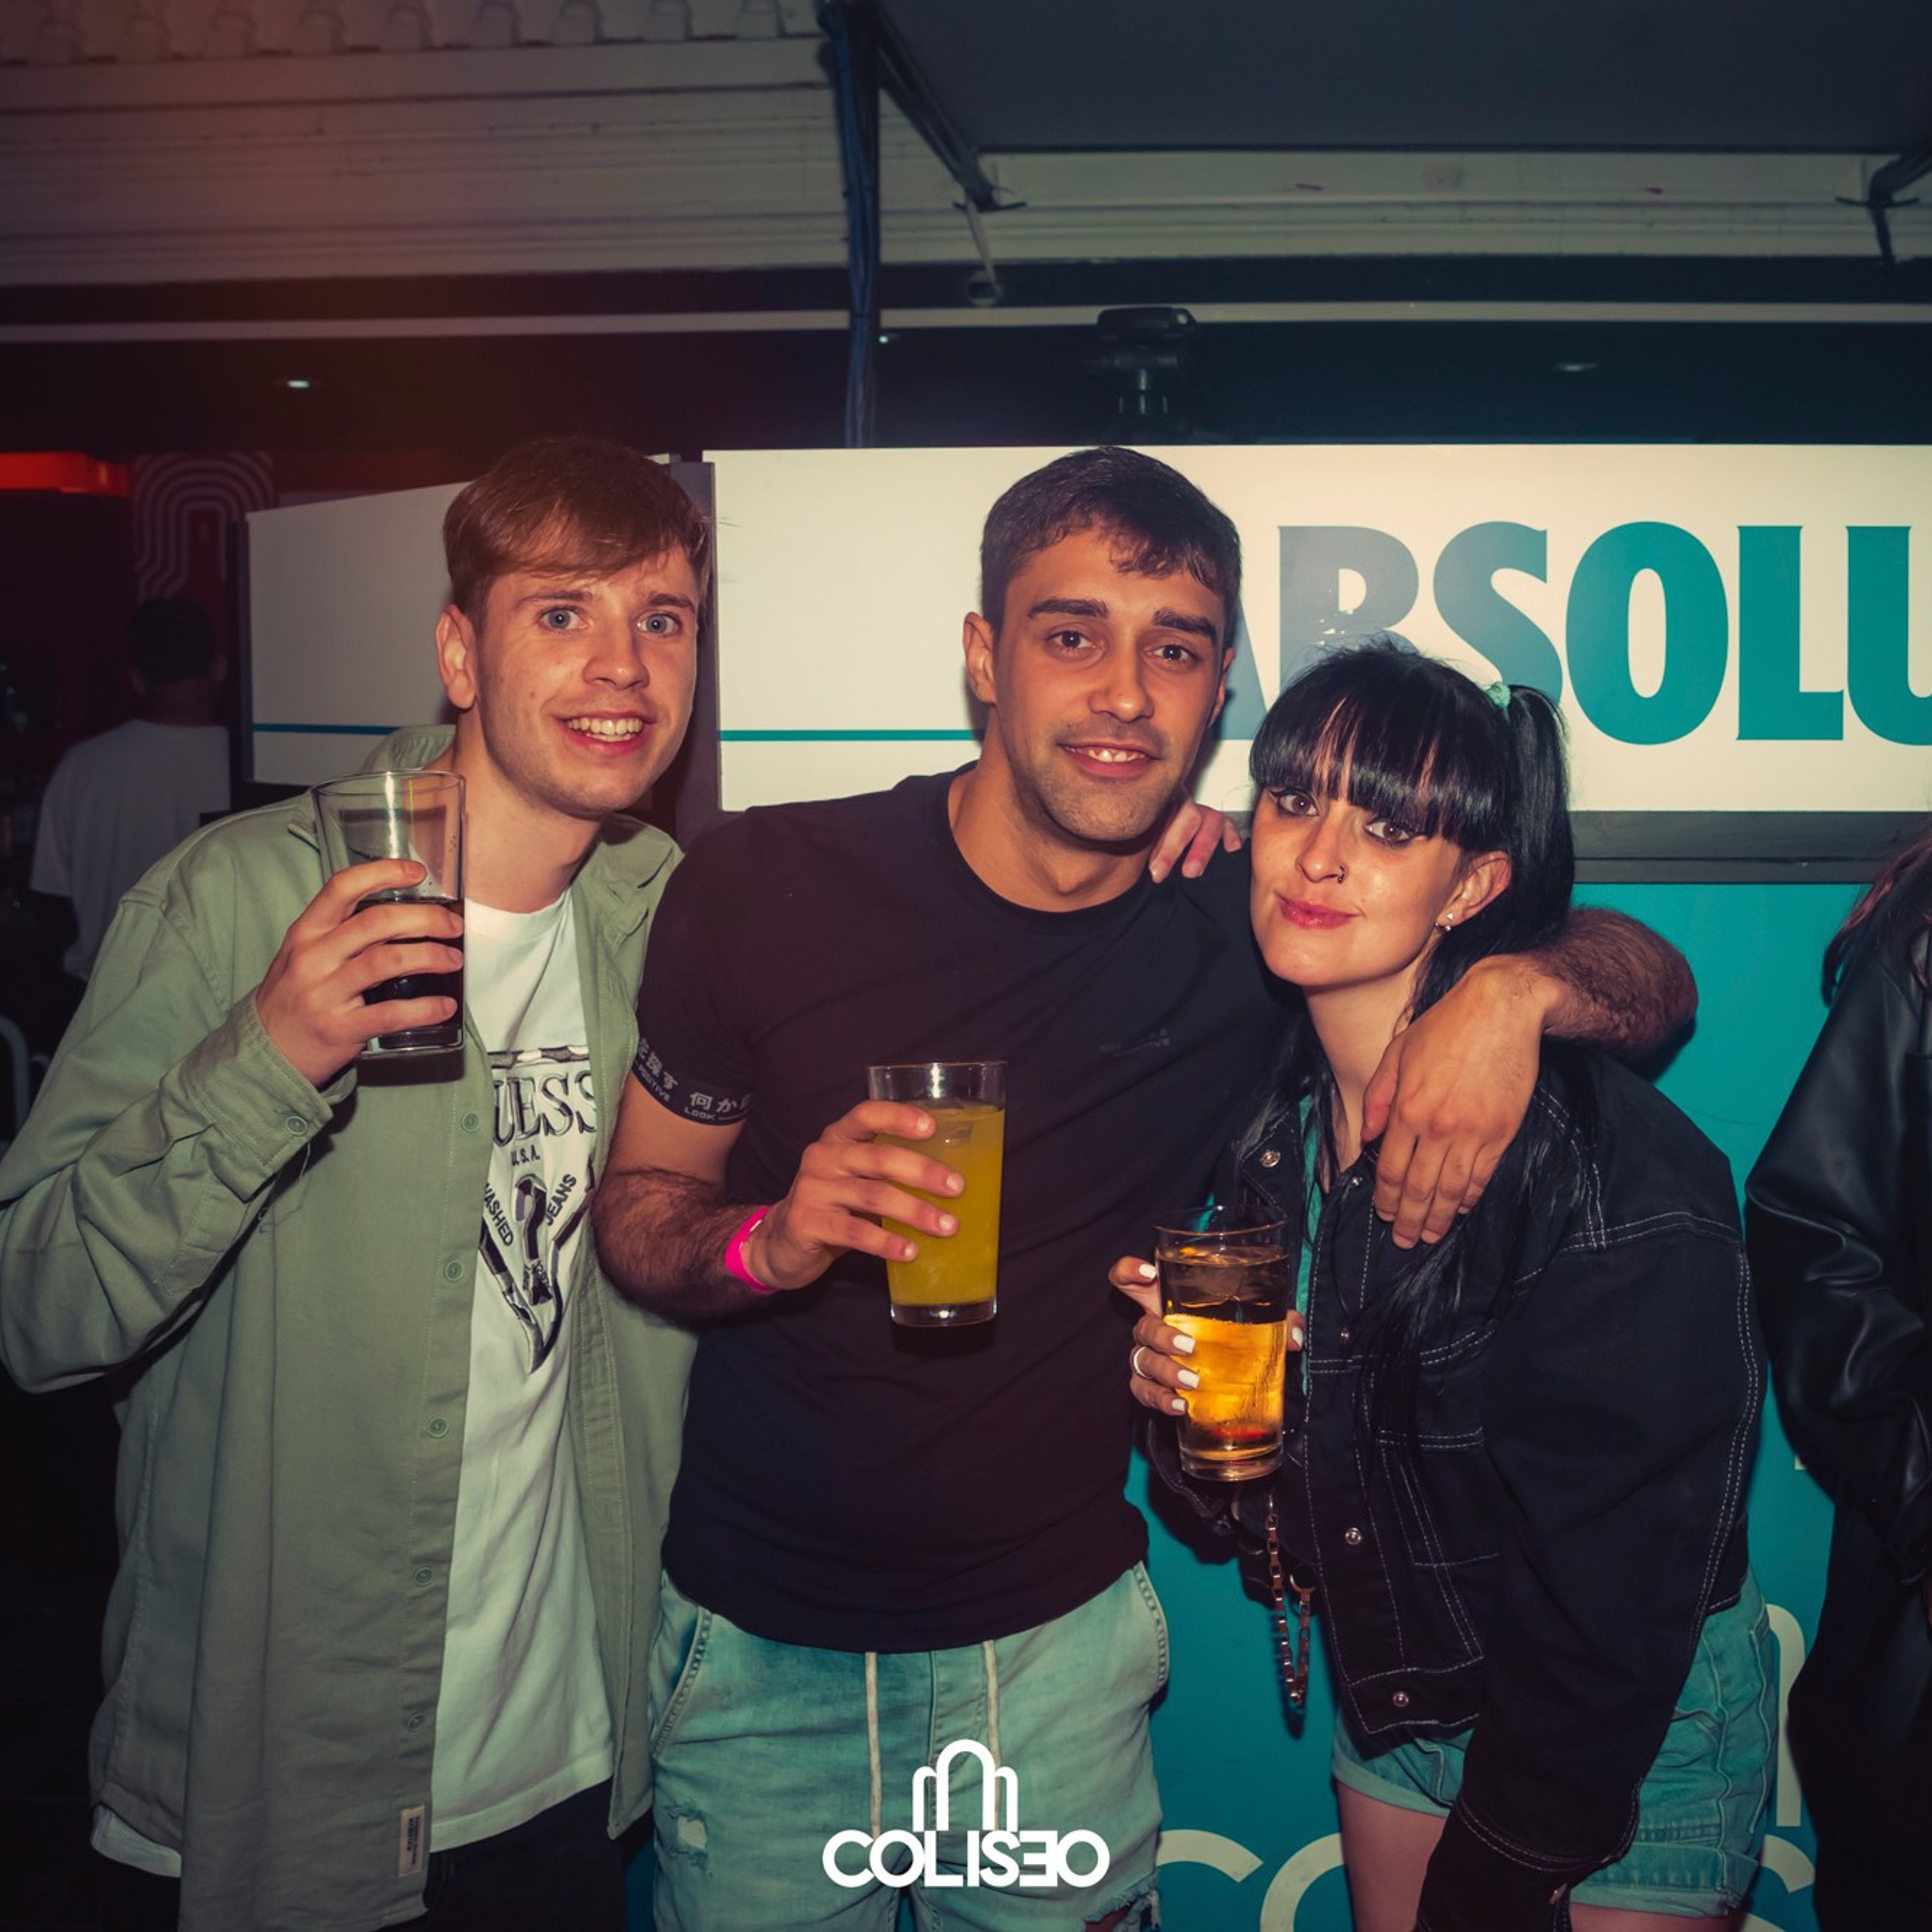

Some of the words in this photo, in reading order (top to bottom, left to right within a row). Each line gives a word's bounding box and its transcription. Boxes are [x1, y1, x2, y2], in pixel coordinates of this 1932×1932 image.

[1212, 521, 1932, 746] BSOLU
[685, 1106, 717, 1121] LOOK
[689, 1091, 750, 1112] 何か
[545, 1174, 577, 1226] JEANS
